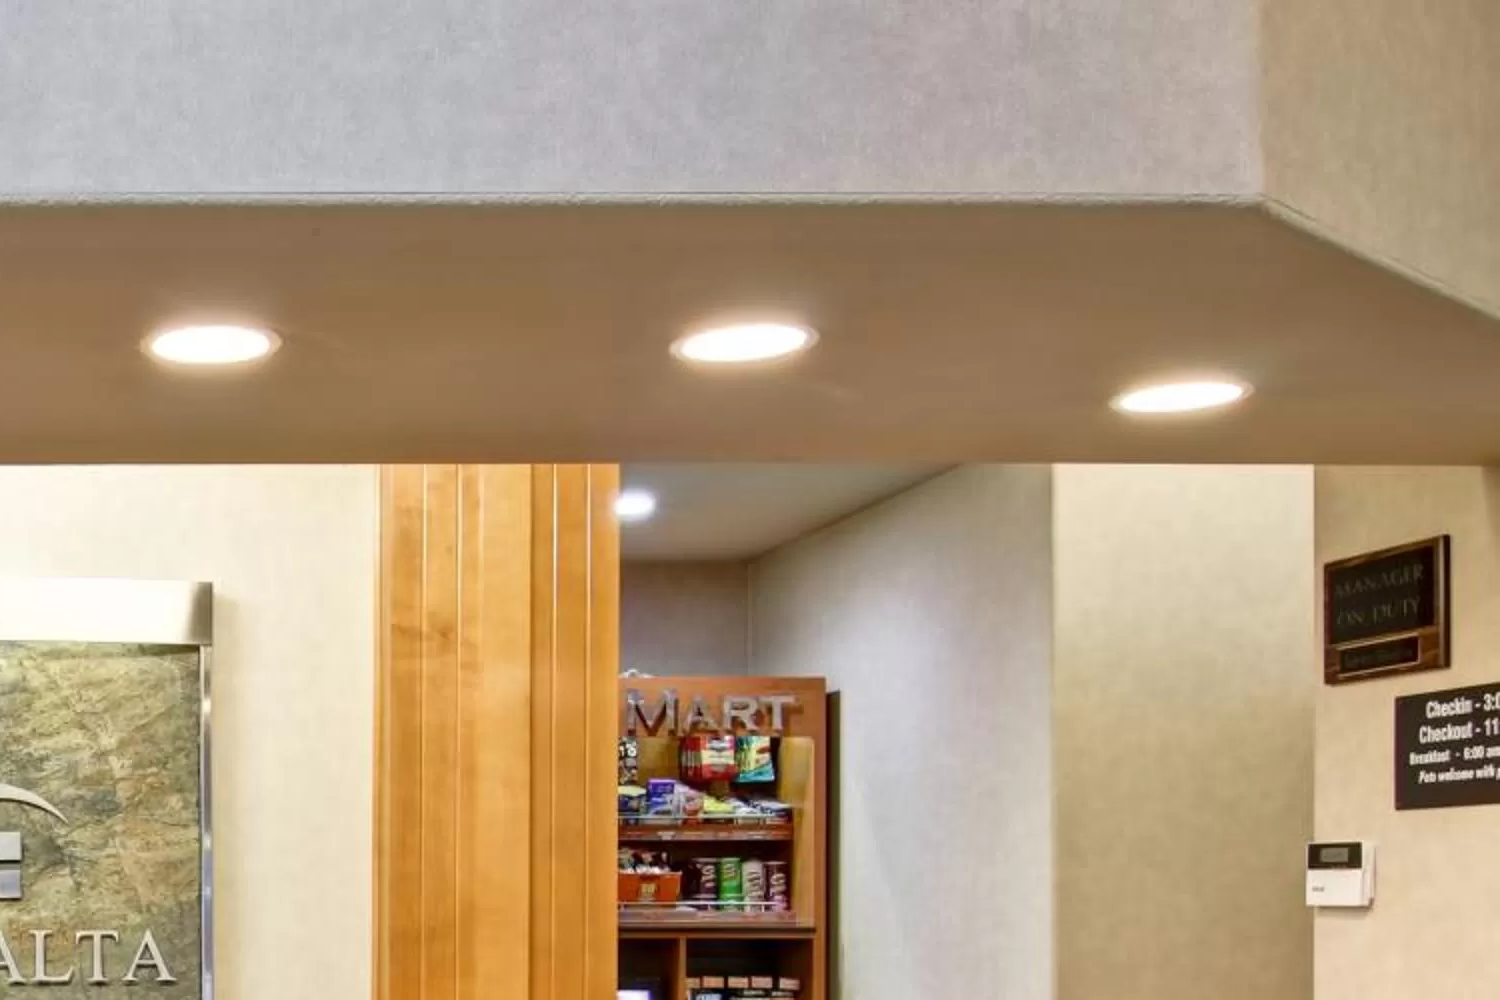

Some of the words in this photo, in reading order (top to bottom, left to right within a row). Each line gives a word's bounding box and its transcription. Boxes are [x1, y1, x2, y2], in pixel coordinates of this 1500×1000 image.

[1335, 563, 1424, 598] MANAGER
[1337, 609, 1364, 625] ON
[1371, 595, 1421, 624] DUTY
[626, 689, 797, 733] MART
[1426, 697, 1473, 719] Checkin
[1419, 721, 1473, 744] Checkout
[1483, 717, 1500, 736] 11
